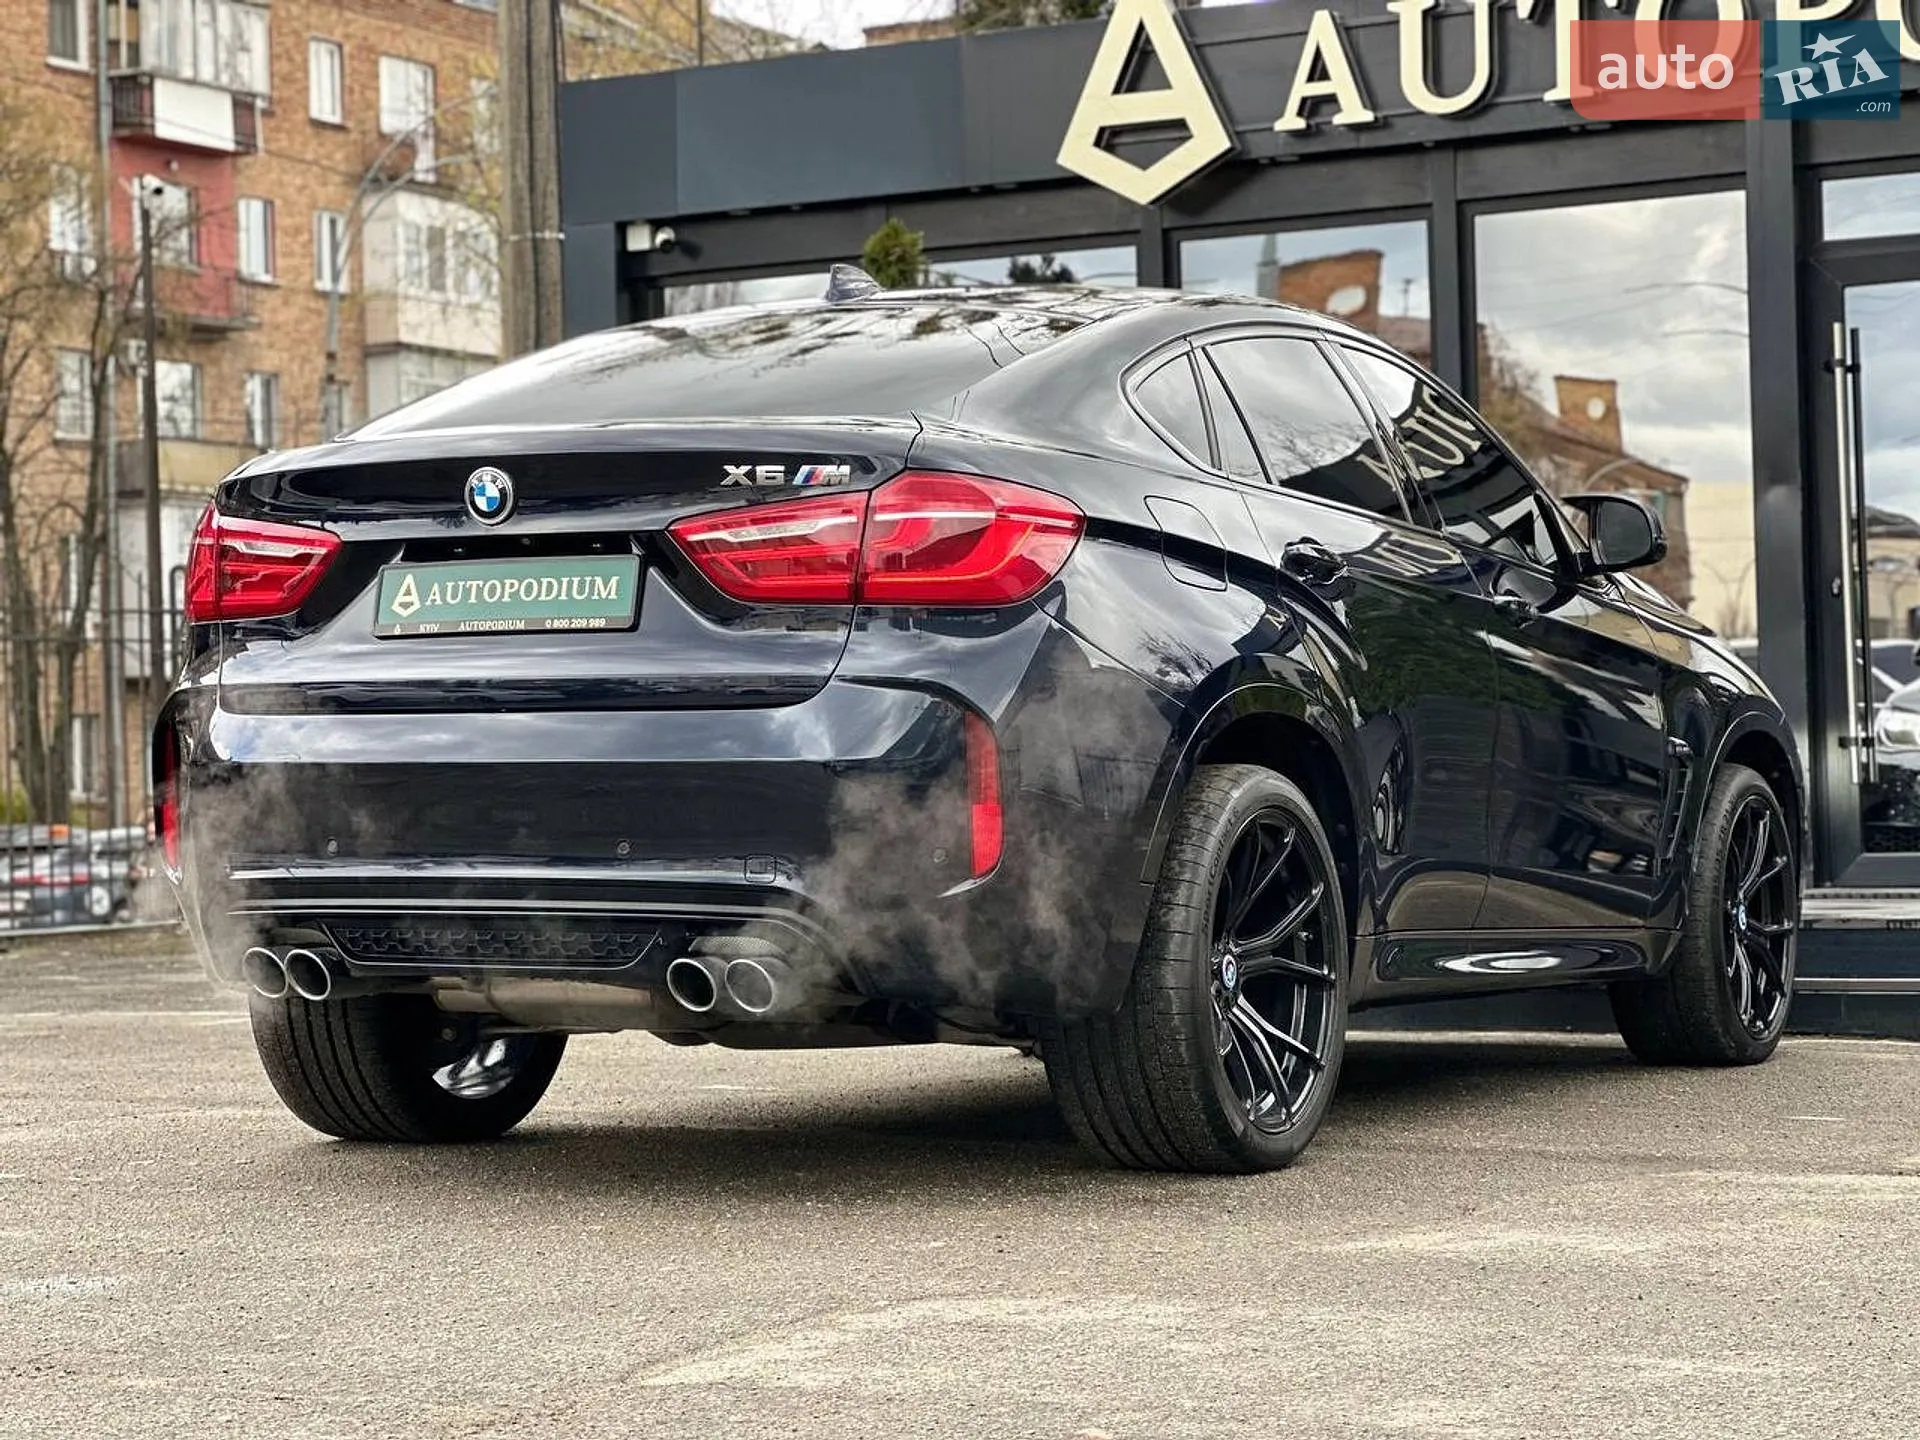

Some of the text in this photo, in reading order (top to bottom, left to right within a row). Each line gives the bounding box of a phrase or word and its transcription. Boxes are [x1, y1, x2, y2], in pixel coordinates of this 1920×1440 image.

[720, 465, 850, 485] X6 M
[424, 576, 620, 606] AUTOPODIUM
[458, 620, 526, 632] AUTOPODIUM
